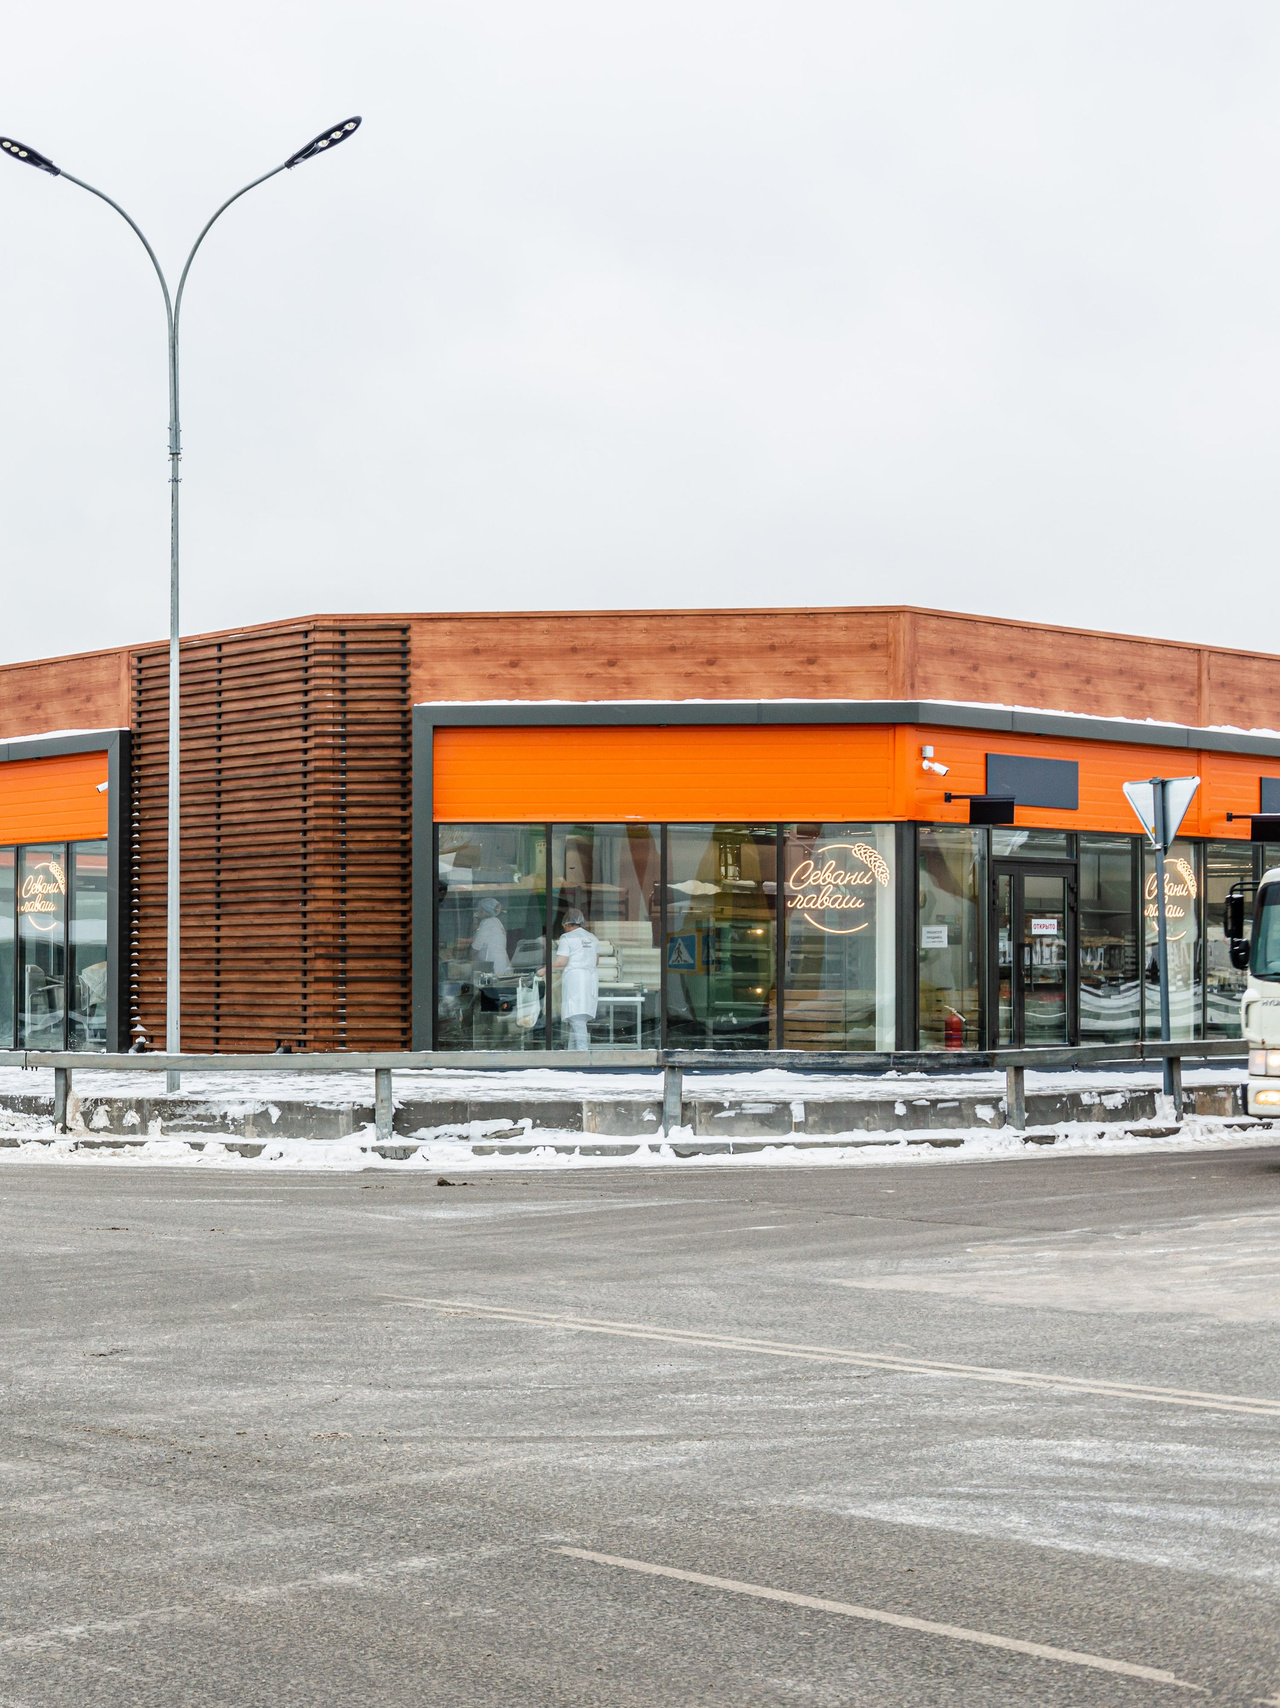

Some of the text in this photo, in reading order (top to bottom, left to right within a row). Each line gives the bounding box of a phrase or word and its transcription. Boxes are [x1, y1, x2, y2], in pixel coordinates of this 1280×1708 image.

[21, 874, 60, 899] Севани
[789, 859, 873, 890] Севани
[787, 884, 865, 909] лаваш
